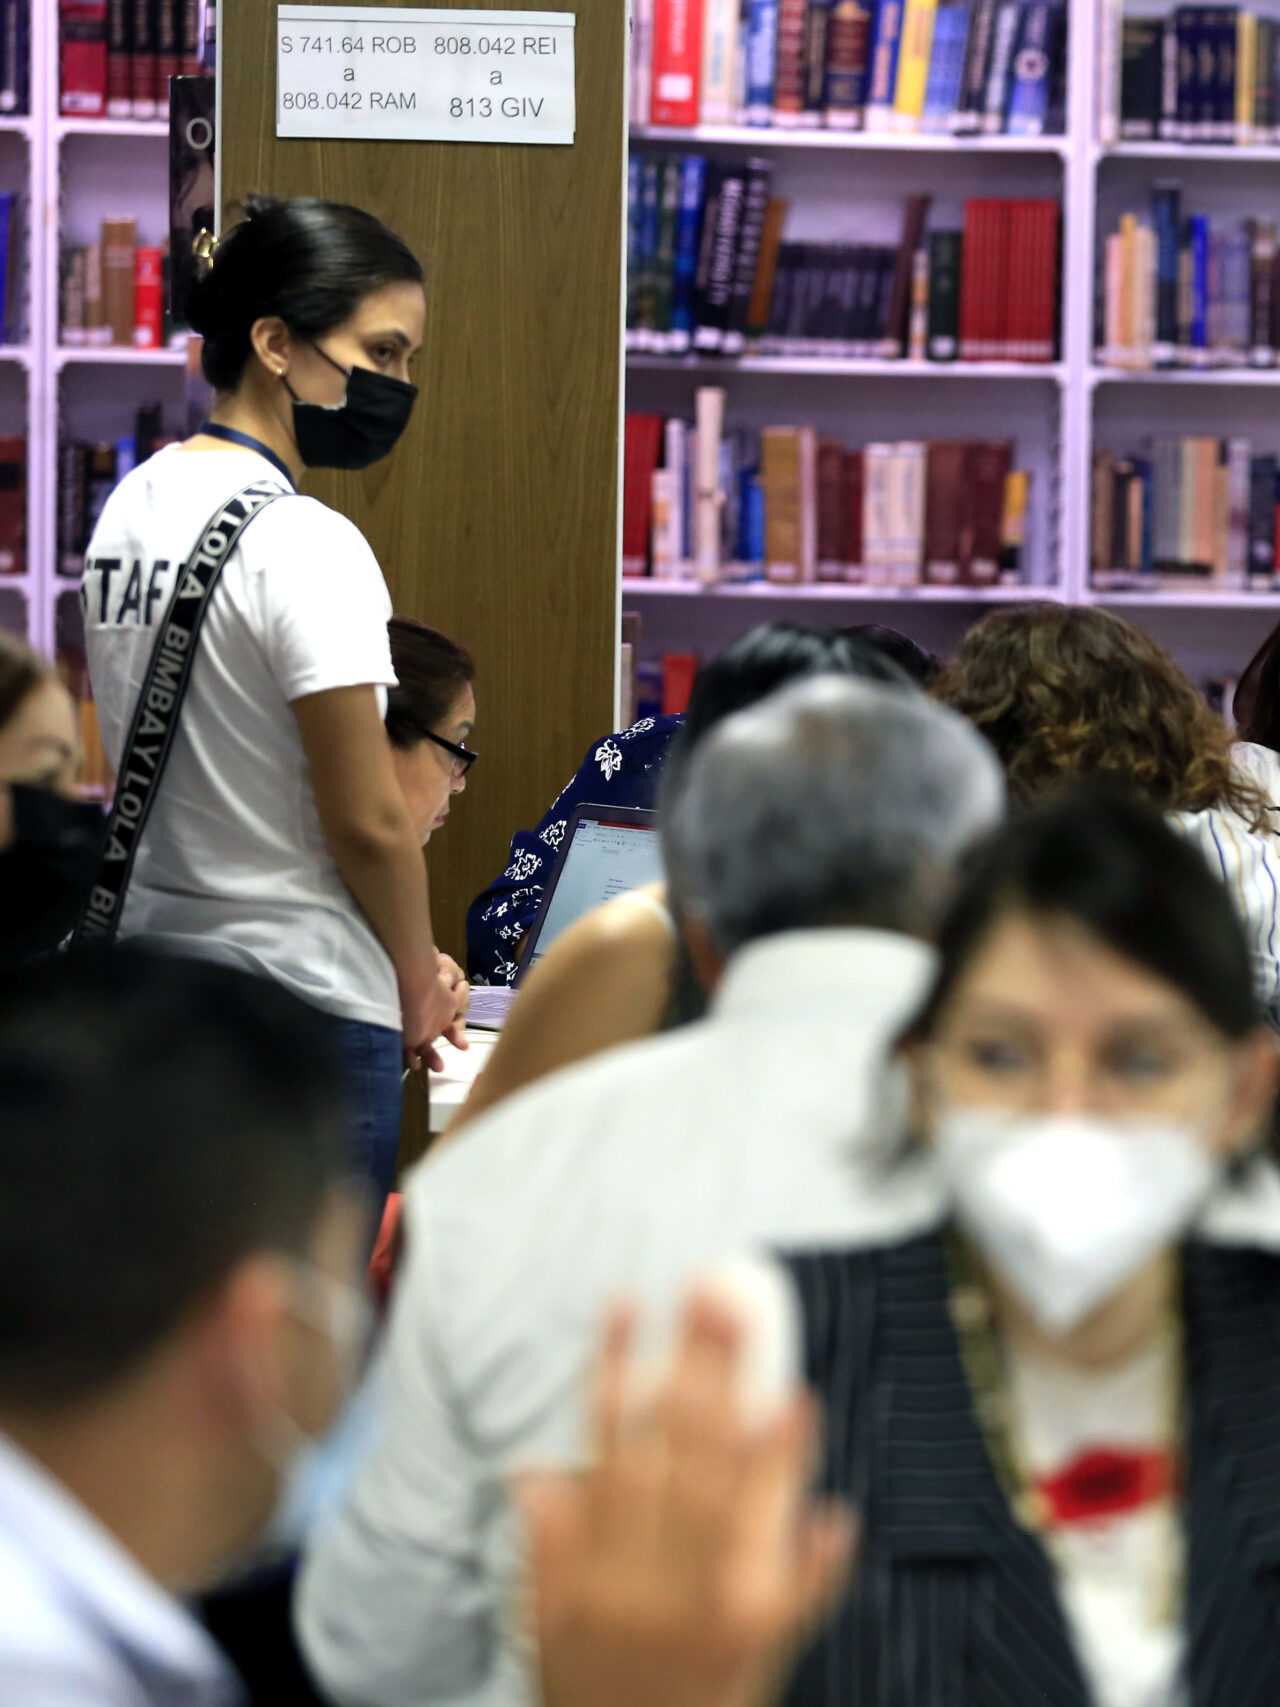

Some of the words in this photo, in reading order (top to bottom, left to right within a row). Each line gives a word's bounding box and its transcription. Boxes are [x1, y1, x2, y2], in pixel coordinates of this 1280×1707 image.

[281, 36, 293, 54] S
[300, 36, 364, 54] 741.64
[372, 37, 417, 54] ROB
[434, 37, 516, 55] 808.042
[523, 38, 556, 55] REI
[343, 67, 355, 82] a
[490, 70, 503, 86] a
[283, 92, 363, 111] 808.042
[370, 92, 416, 110] RAM
[449, 97, 493, 118] 813
[501, 97, 544, 118] GIV
[81, 558, 187, 625] TAF
